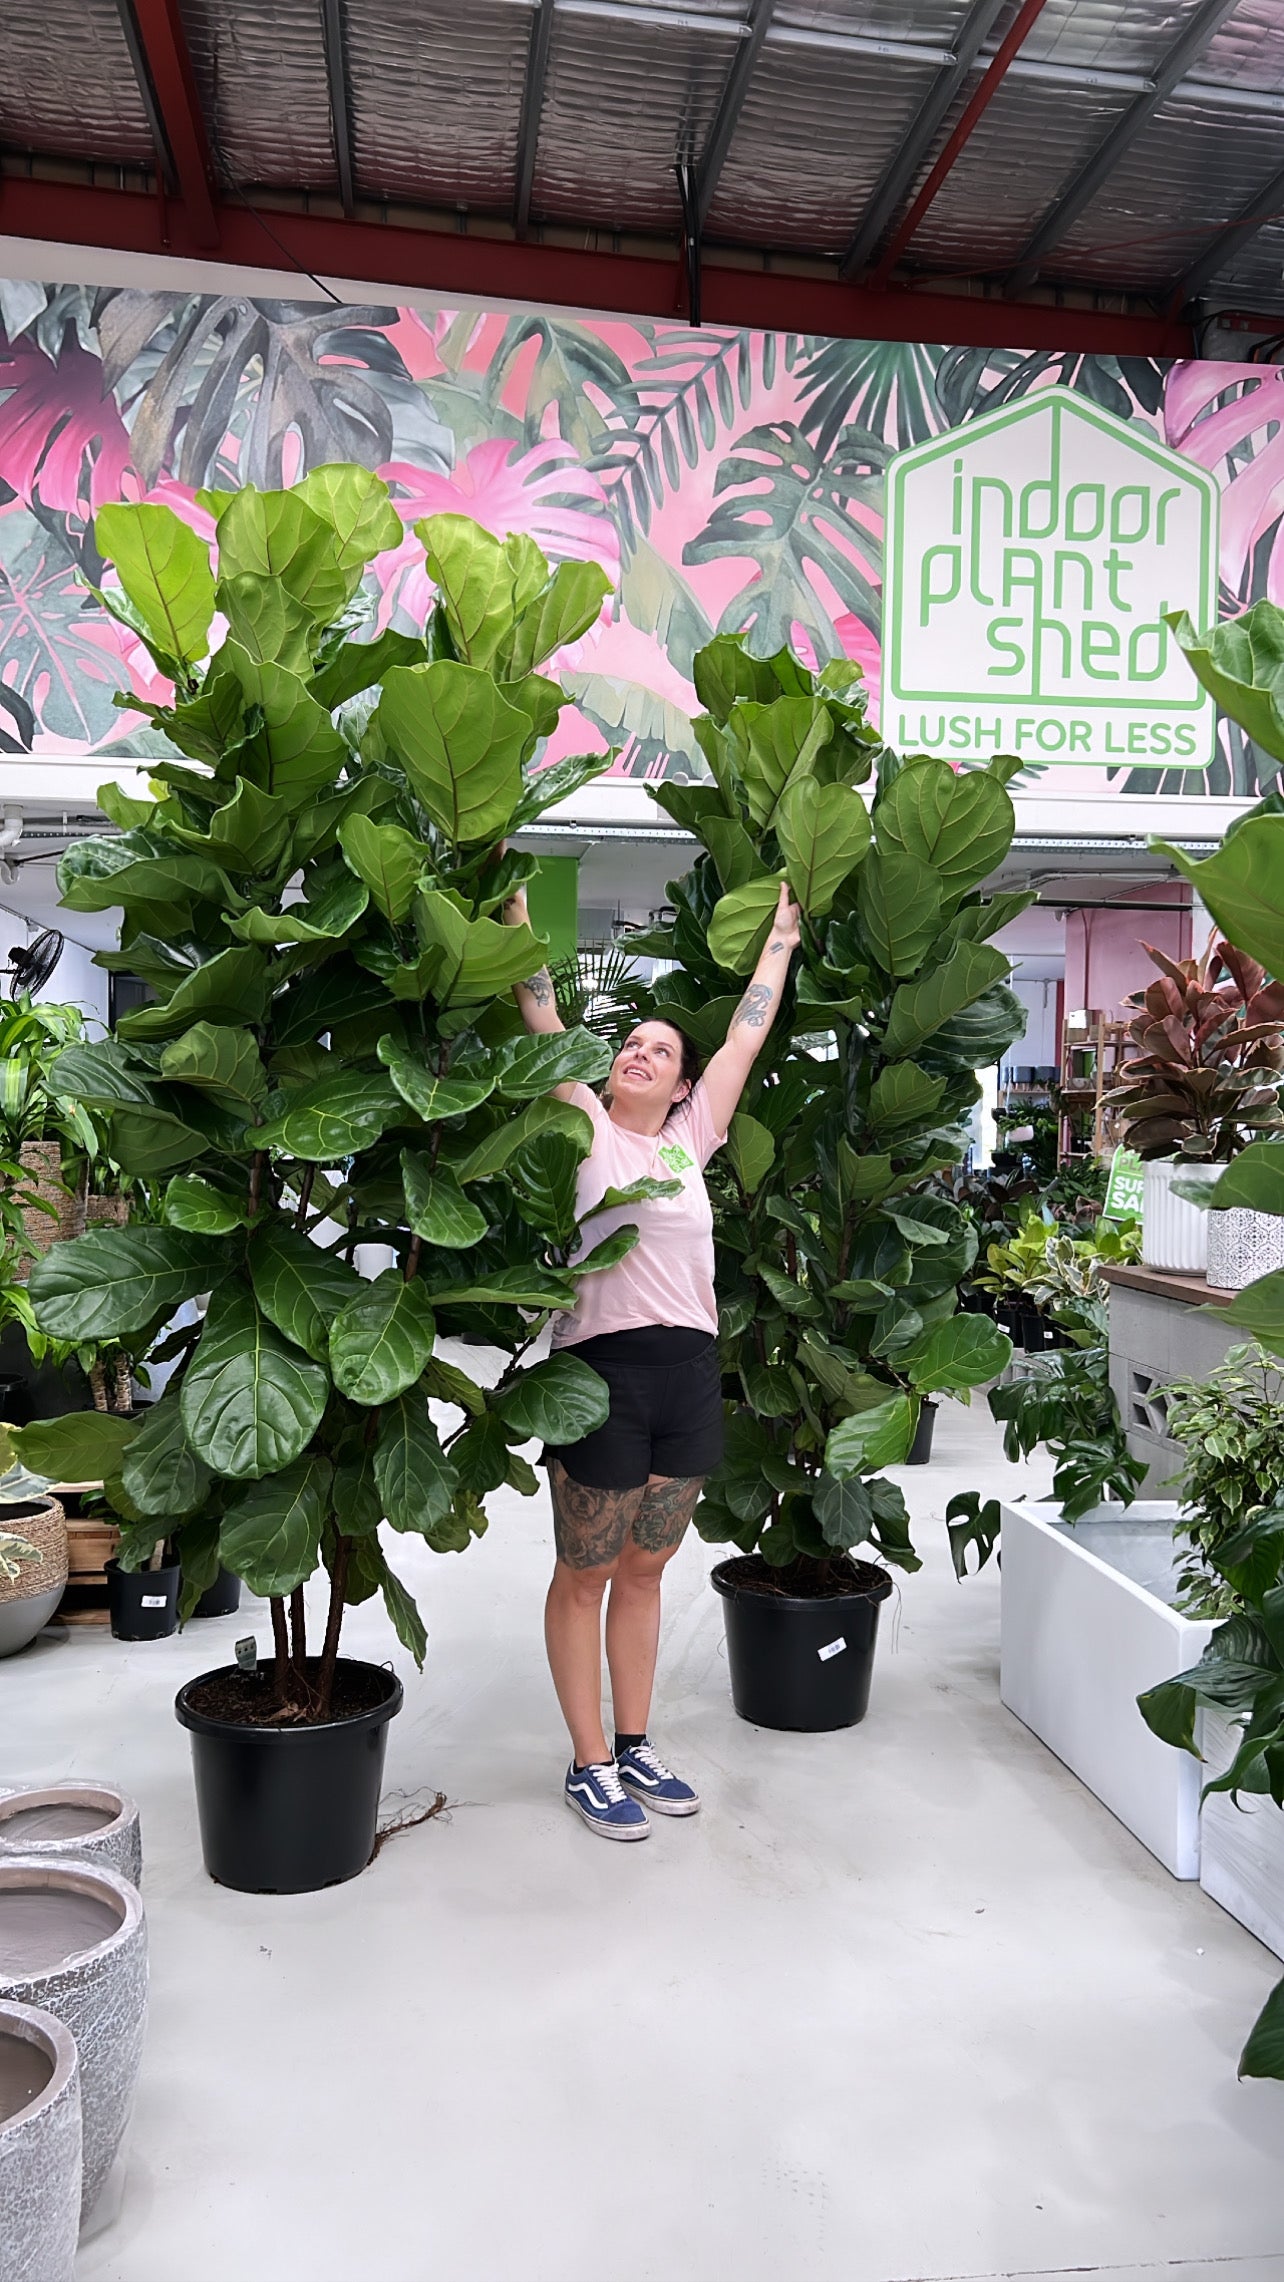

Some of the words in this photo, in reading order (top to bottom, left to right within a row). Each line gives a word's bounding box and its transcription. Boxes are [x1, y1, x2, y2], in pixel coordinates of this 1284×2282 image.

[952, 458, 1181, 545] indoor
[899, 714, 1001, 750] LUSH
[1015, 718, 1092, 752] FOR
[1105, 722, 1197, 755] LESS
